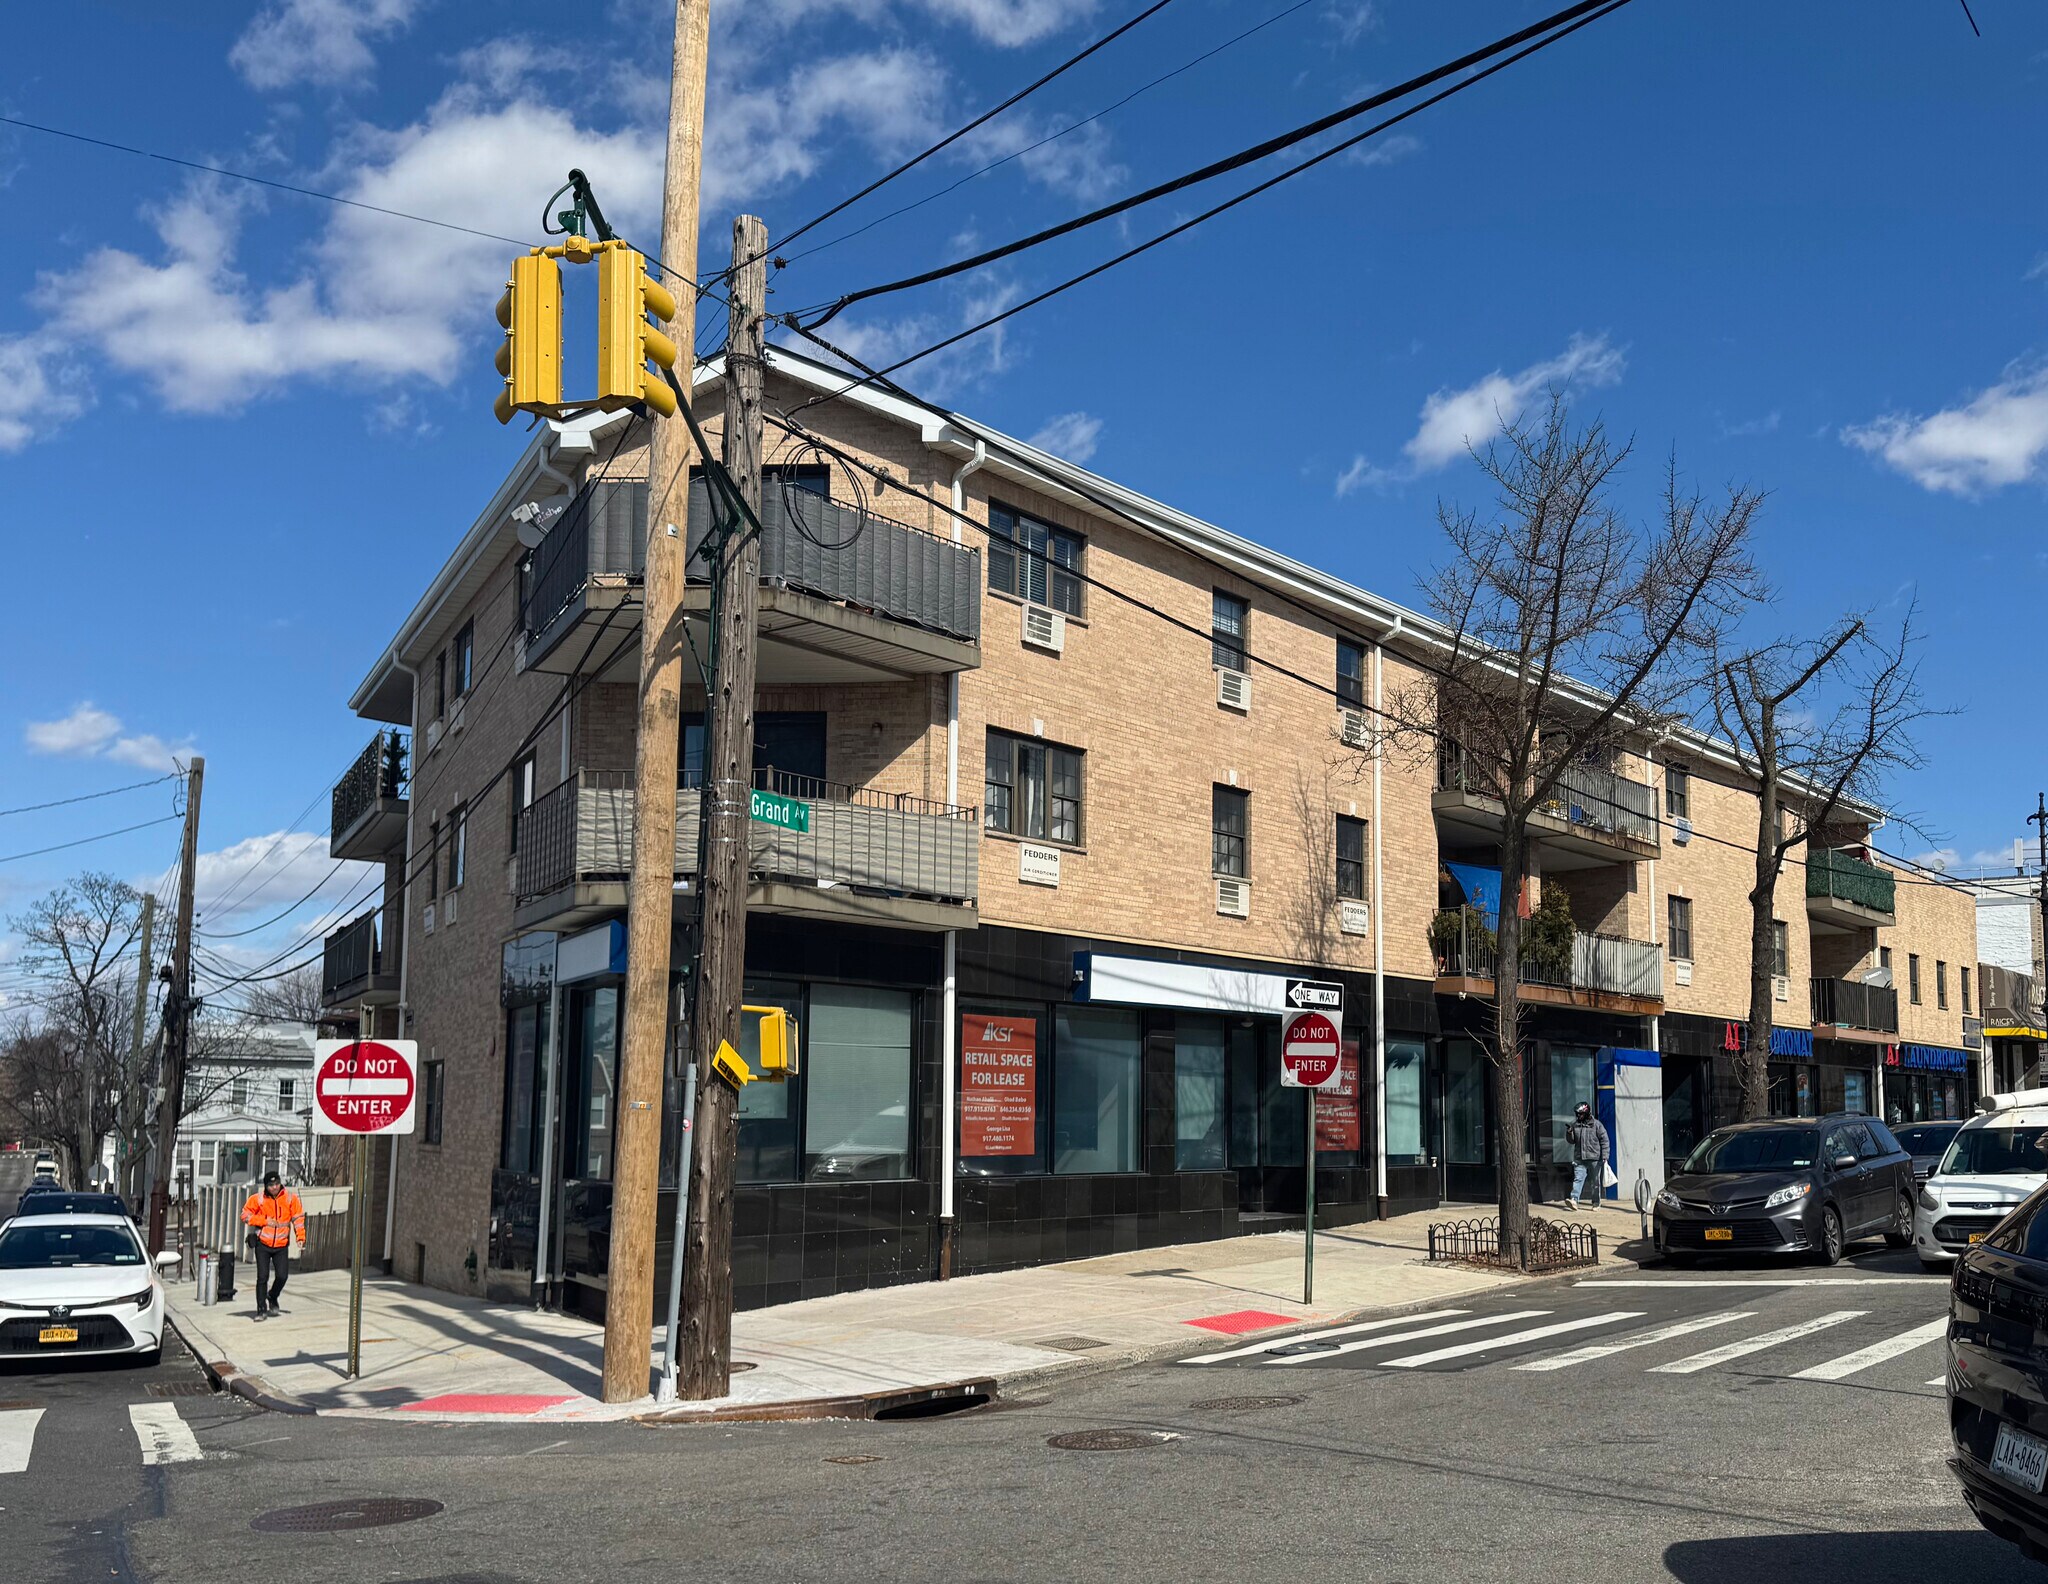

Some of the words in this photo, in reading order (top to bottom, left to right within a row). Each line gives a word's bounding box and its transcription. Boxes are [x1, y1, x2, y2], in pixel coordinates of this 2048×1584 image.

[751, 793, 789, 824] Grand
[794, 805, 805, 820] Av
[1024, 849, 1058, 862] FEDDERS
[1344, 906, 1367, 916] FEDDERS
[1294, 988, 1312, 1001] ONE
[1318, 991, 1336, 1004] WAY
[1293, 1027, 1307, 1039] DO
[1310, 1027, 1330, 1039] NOT
[965, 1052, 999, 1066] RETAIL
[1000, 1053, 1033, 1067] SPACE
[1294, 1059, 1327, 1072] ENTER
[1904, 1045, 1967, 1073] LAUNDROMAT
[334, 1059, 358, 1075] DO
[364, 1059, 398, 1075] NOT
[971, 1071, 992, 1085] FOR
[993, 1072, 1026, 1086] LEASE
[1340, 1070, 1357, 1081] PACE
[337, 1099, 392, 1115] ENTER
